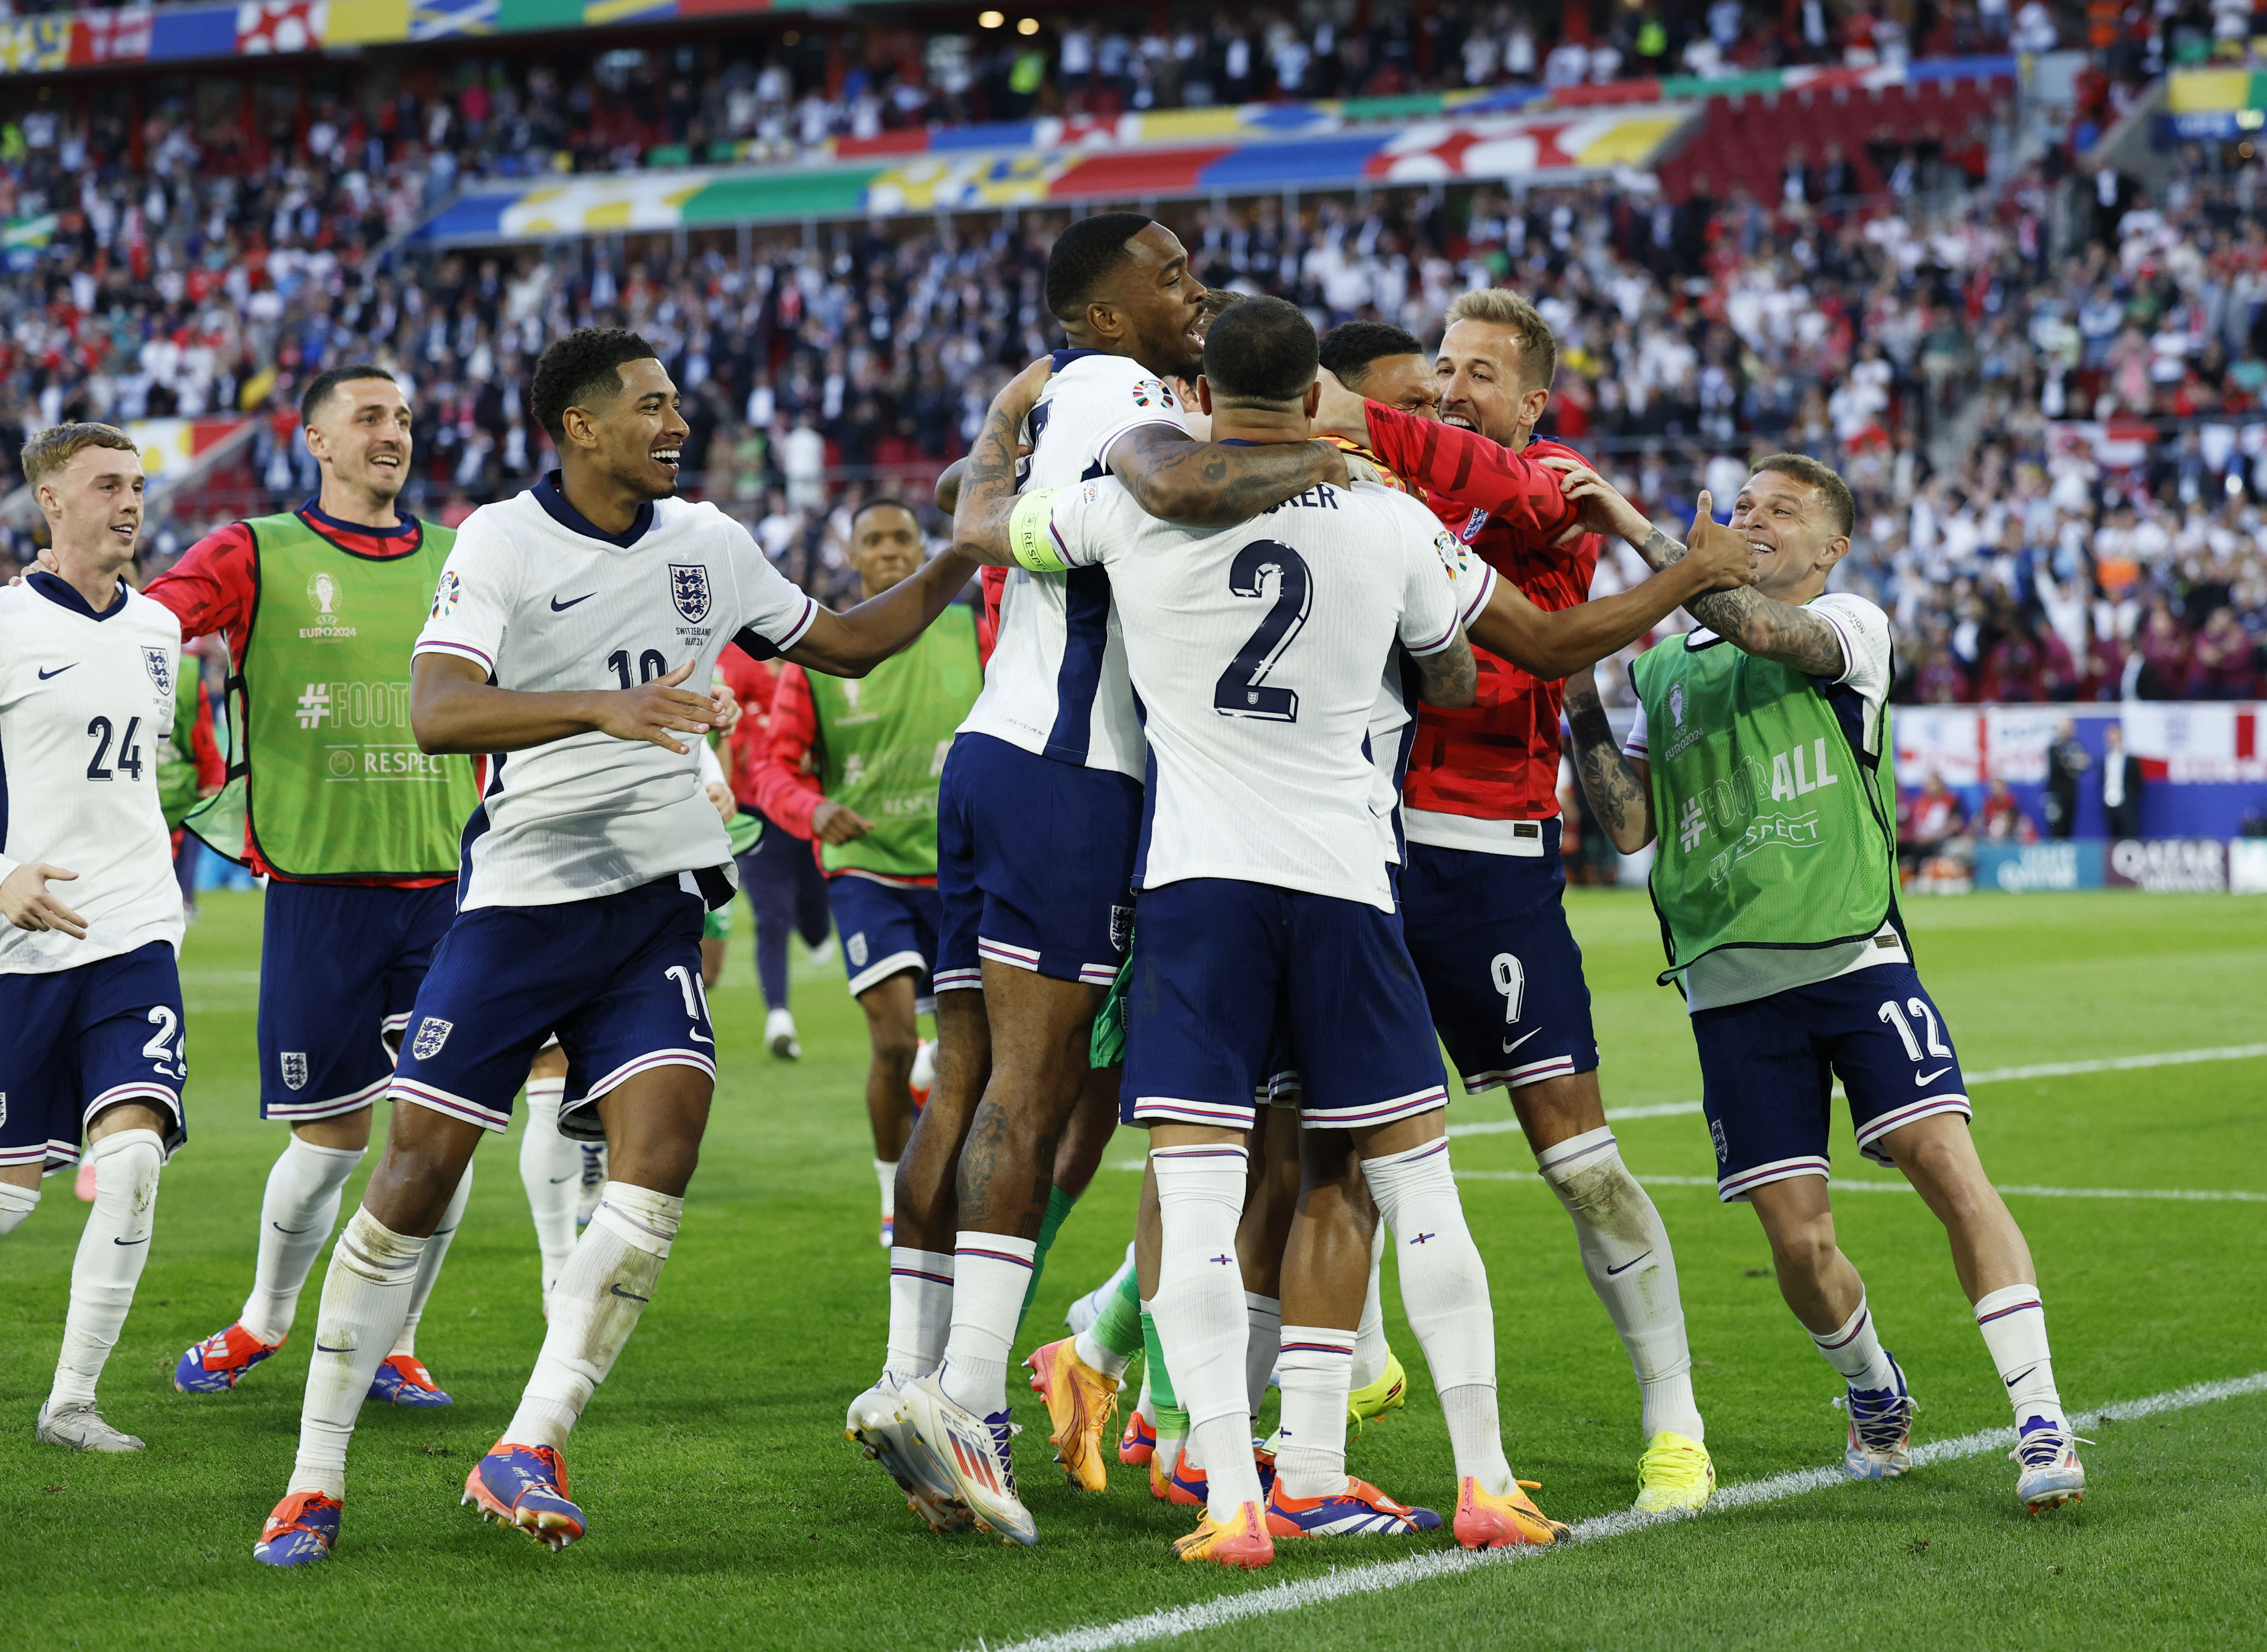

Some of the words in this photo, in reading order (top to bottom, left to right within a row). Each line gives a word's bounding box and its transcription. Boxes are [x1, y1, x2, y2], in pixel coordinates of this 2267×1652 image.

[1024, 532, 1053, 572] RESPEC
[299, 627, 357, 638] EURO2024
[676, 627, 711, 636] SWITZERLAND
[1214, 539, 1313, 723] 2
[1817, 602, 1865, 634] NDATION
[295, 682, 412, 729] #FOOT
[87, 716, 143, 781] 24
[1665, 727, 1704, 761] EURO2024
[365, 752, 449, 774] RESPEC
[1737, 818, 1819, 854] SPECT
[1491, 952, 1524, 1024] 9
[1877, 997, 1953, 1062] 12
[1301, 1508, 1323, 1517] PREDATOR
